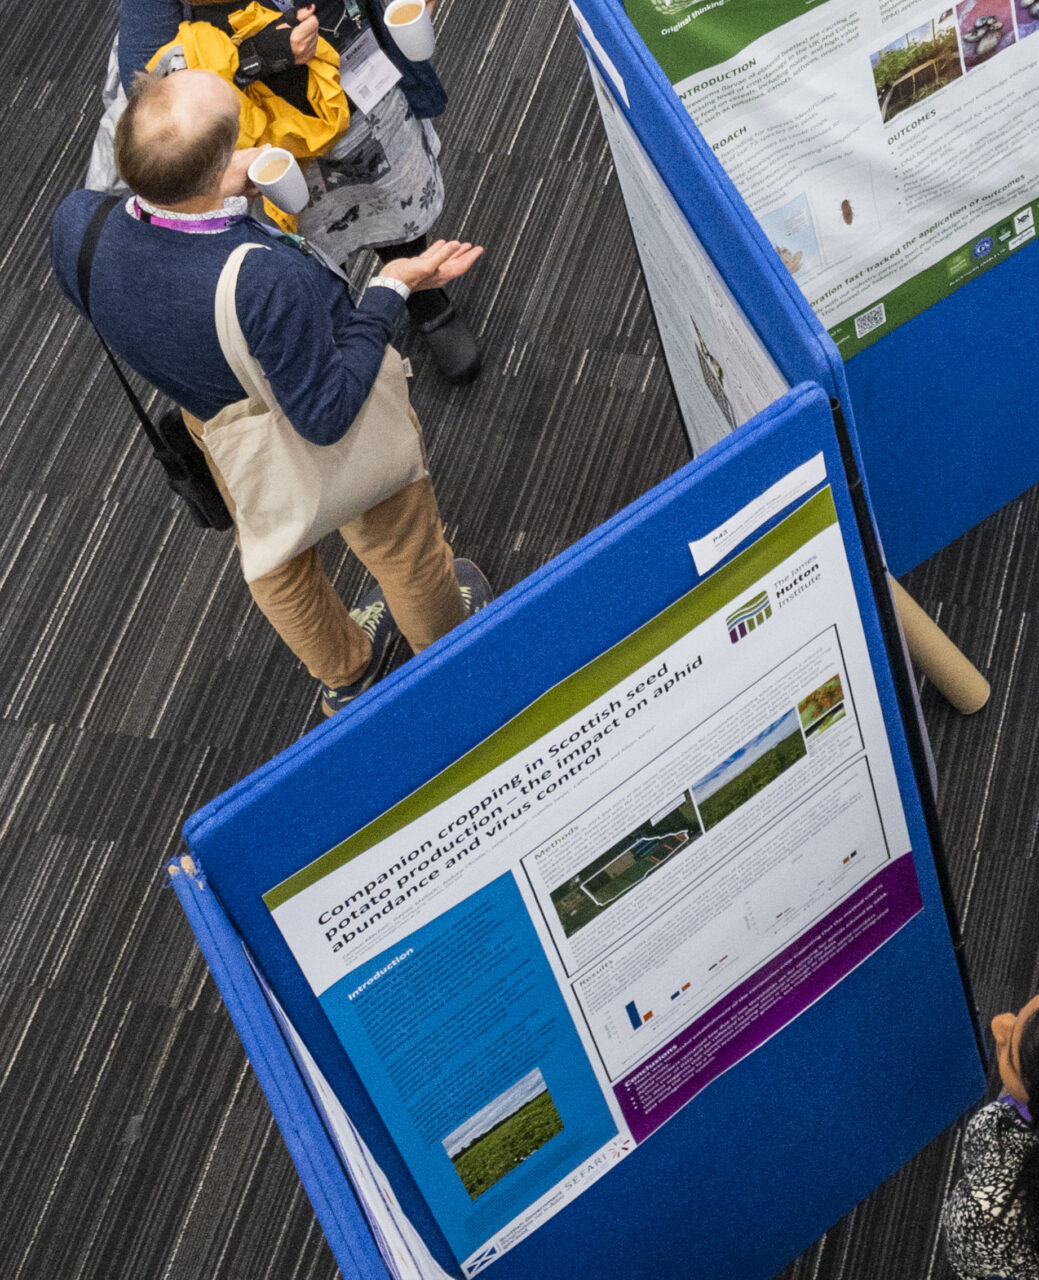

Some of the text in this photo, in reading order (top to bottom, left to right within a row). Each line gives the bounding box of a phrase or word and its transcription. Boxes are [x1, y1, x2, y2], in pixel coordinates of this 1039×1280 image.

[661, 12, 691, 39] Original
[678, 57, 756, 102] NTRODUCTION
[686, 87, 719, 110] ireworms
[712, 125, 746, 152] ROACH
[887, 107, 936, 146] OUTCOMES
[810, 282, 842, 307] oration
[902, 236, 916, 250] the
[918, 203, 966, 240] application
[712, 528, 728, 543] P43
[773, 552, 817, 589] The James
[775, 560, 819, 599] Hutton
[777, 570, 821, 609] Institute
[316, 835, 433, 929] Companion
[435, 770, 522, 842] cropping
[524, 753, 544, 775] in
[547, 696, 622, 759] Scottish
[624, 661, 669, 702] seed
[323, 884, 393, 942] potato
[394, 802, 504, 889] production
[518, 765, 552, 797] the
[555, 715, 621, 771] impact
[623, 695, 648, 720] on
[651, 653, 704, 701] aphid
[329, 865, 440, 953] abundance
[443, 835, 481, 869] and
[484, 798, 532, 839] virus
[534, 745, 602, 802] control
[534, 823, 579, 861] Methods
[347, 946, 414, 1001] Introduction
[579, 958, 613, 987] Results
[624, 1042, 677, 1088] Conclusions
[564, 1152, 607, 1192] SEFARI
